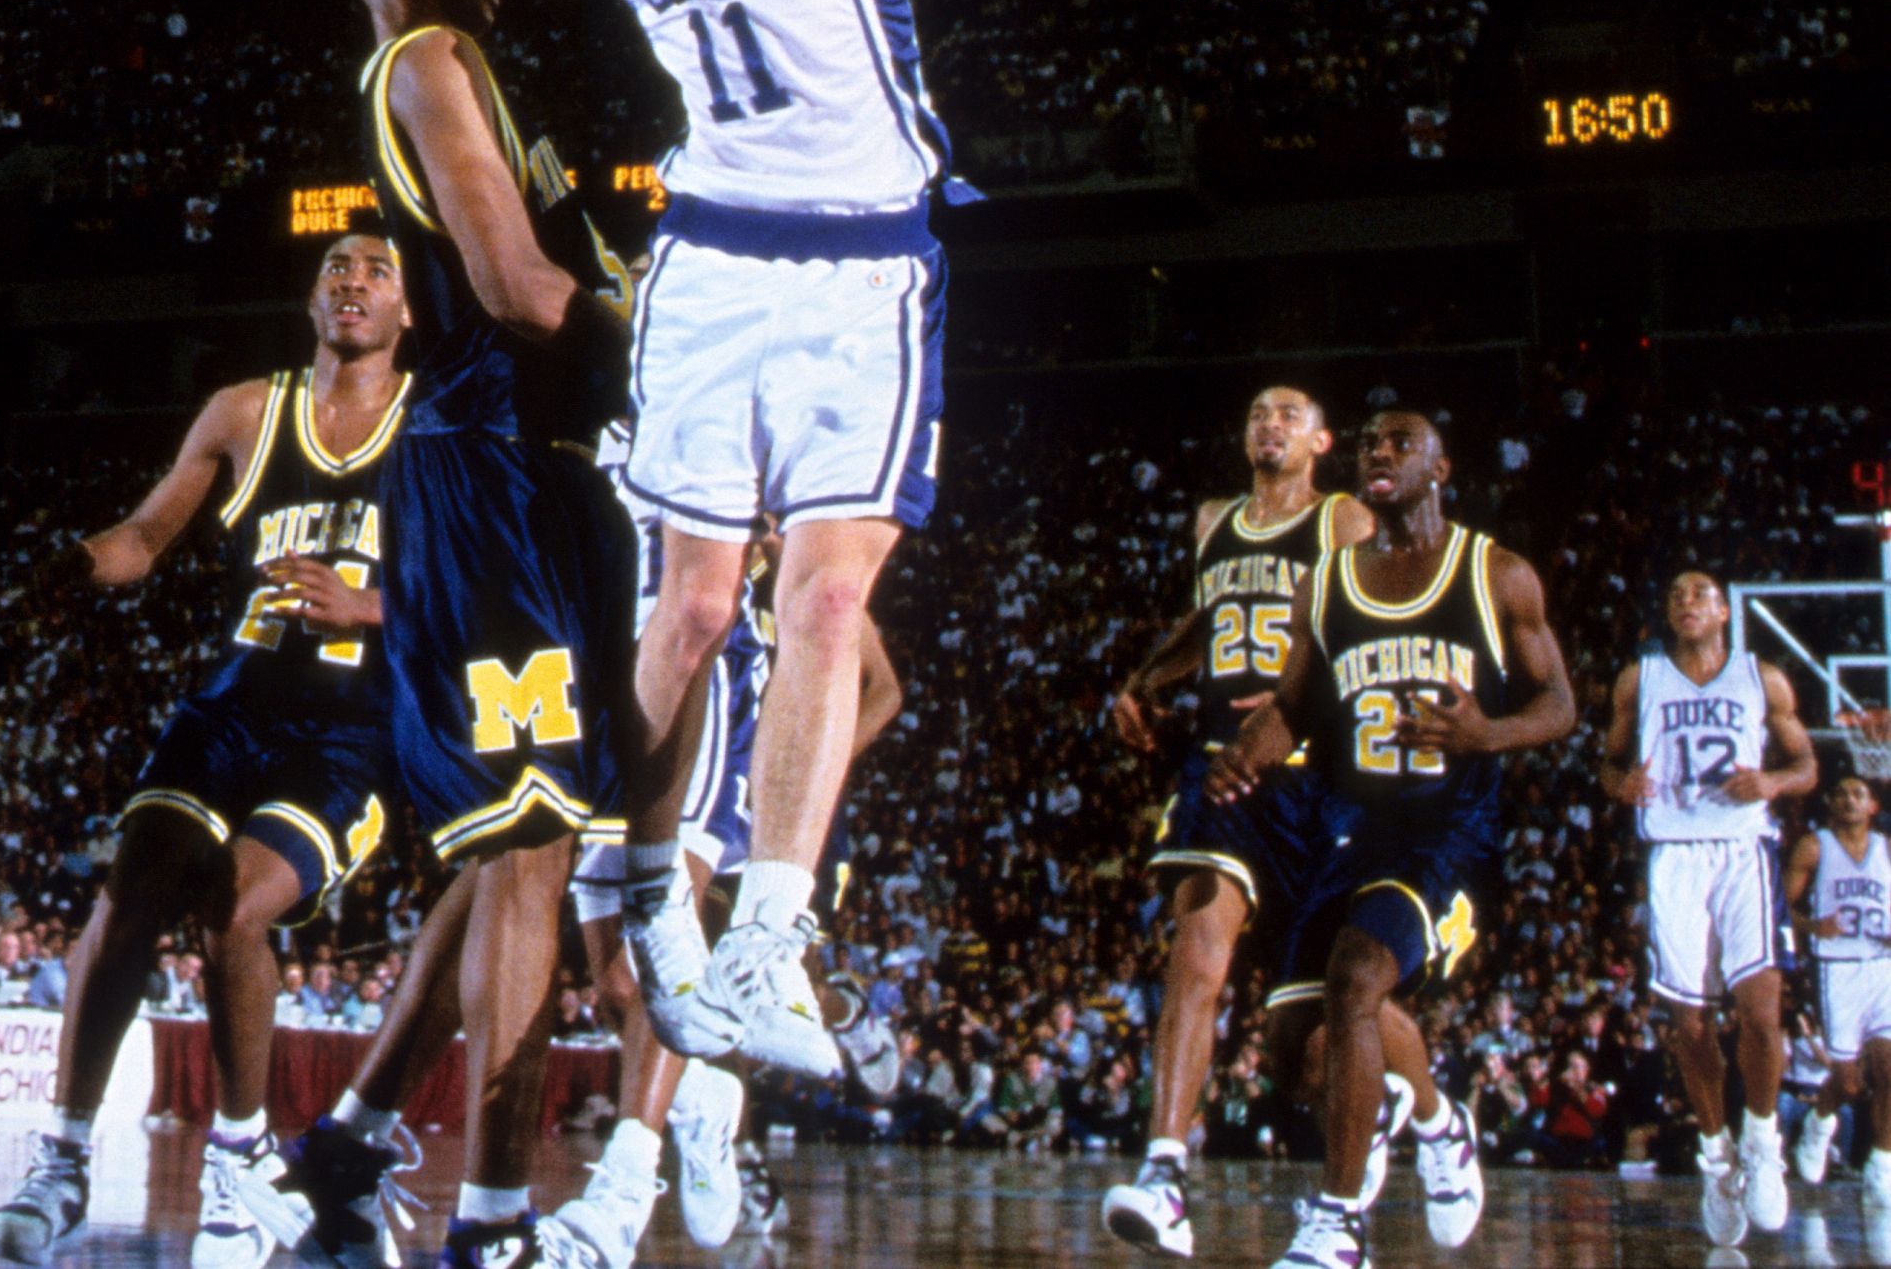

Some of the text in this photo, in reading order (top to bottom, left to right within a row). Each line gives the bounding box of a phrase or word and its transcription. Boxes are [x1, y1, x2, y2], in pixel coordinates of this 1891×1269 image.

[688, 2, 792, 123] 11
[1542, 92, 1672, 147] 16:50
[292, 209, 350, 234] DUKE
[648, 186, 666, 210] 2
[1851, 458, 1891, 507] 4
[1211, 602, 1293, 680] 25
[1332, 635, 1475, 702] MICHIGAN
[466, 647, 582, 753] M
[1661, 698, 1744, 733] DUKE
[1675, 734, 1737, 786] 12
[1834, 877, 1885, 904] DUKE
